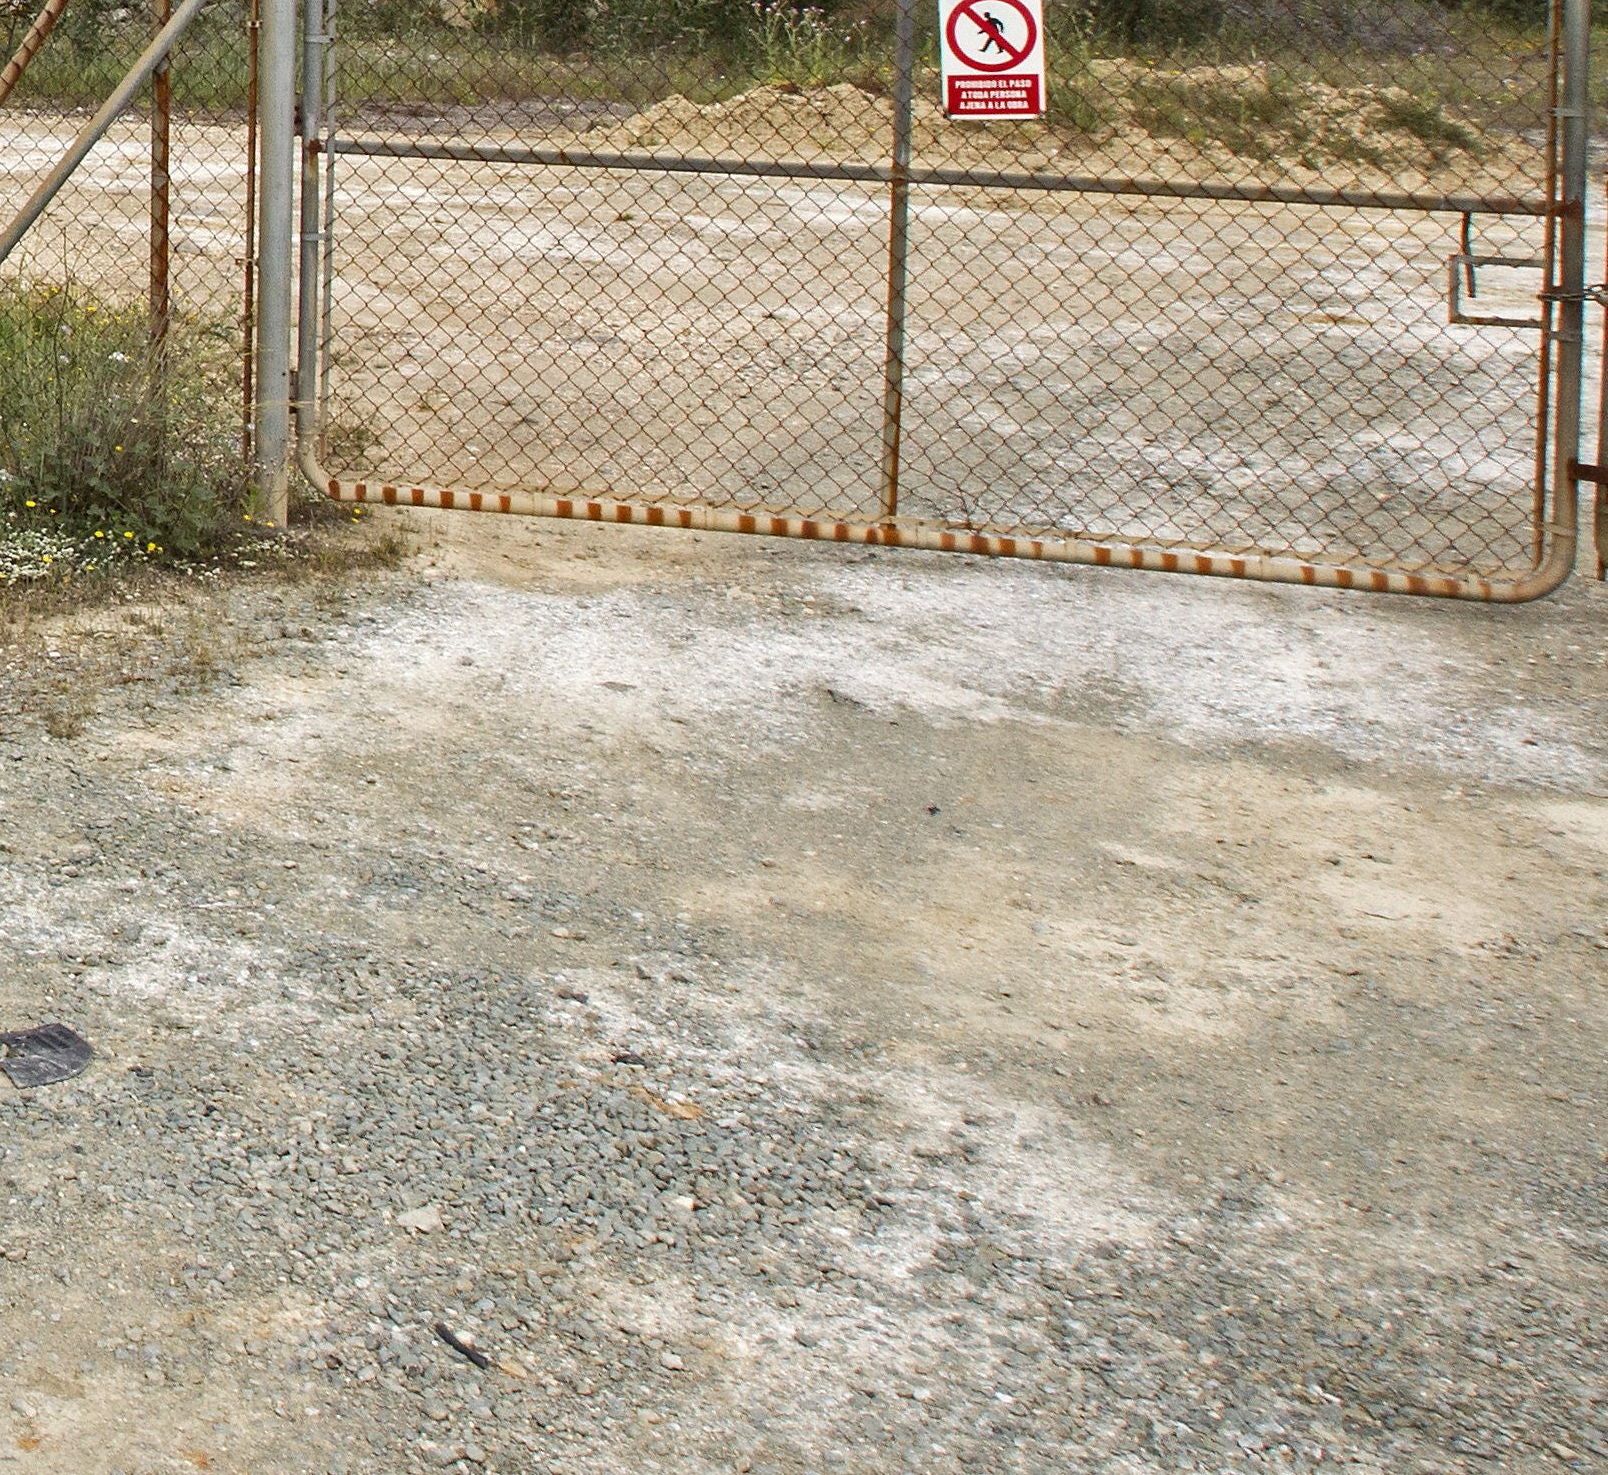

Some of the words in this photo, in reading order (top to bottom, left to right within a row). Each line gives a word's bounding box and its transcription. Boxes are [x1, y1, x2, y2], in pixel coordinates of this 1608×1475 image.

[955, 80, 997, 89] PROHIBIDO
[998, 80, 1008, 88] EL
[1009, 79, 1032, 88] PASO
[989, 90, 1028, 99] PERSONA
[959, 101, 986, 110] AJENA
[987, 101, 994, 109] A
[995, 101, 1006, 109] LA
[1007, 100, 1029, 109] OBRA
